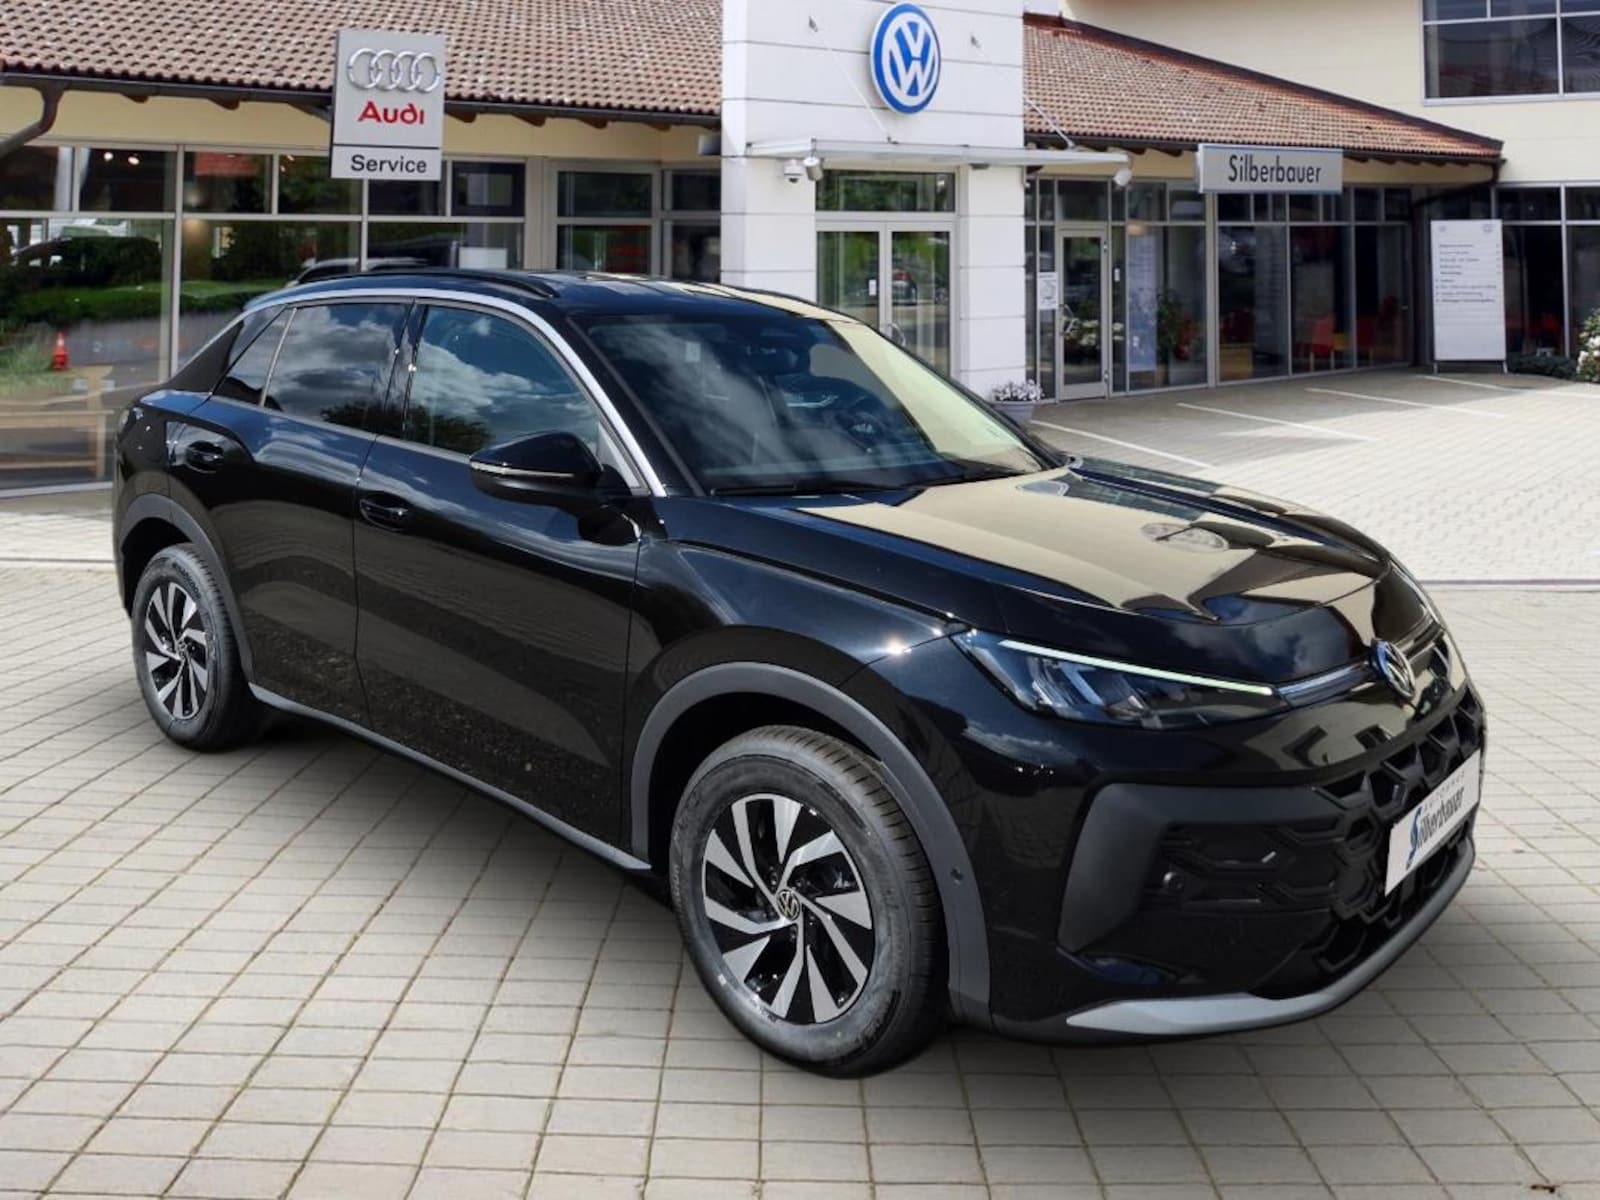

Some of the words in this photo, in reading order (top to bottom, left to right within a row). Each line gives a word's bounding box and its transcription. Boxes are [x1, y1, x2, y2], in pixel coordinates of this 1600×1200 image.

[357, 101, 425, 125] Audi
[350, 154, 428, 173] Service
[1227, 153, 1322, 183] Silberbauer
